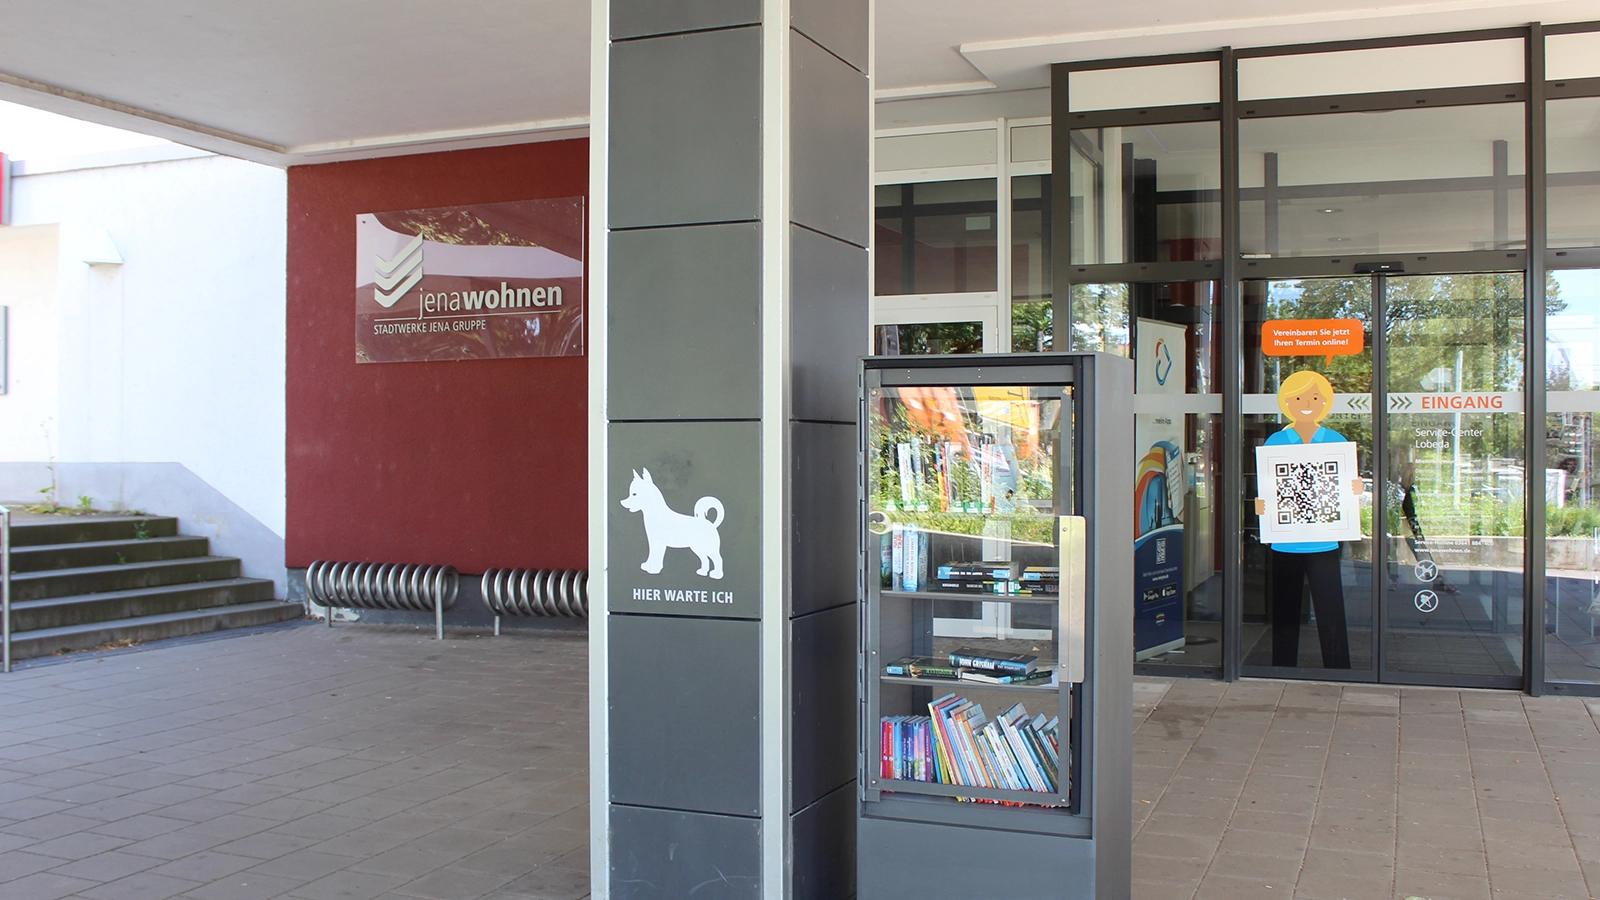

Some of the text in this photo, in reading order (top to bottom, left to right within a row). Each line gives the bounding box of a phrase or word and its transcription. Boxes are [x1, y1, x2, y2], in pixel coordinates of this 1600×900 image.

[418, 282, 562, 320] jenawohnen
[373, 319, 486, 335] STADTWERKE JENA GRUPPE
[1272, 328, 1350, 337] Vereinbaren Sie jetzt
[1273, 339, 1294, 347] Ihren
[1321, 338, 1349, 346] online!
[1421, 395, 1503, 410] EINGANG
[1415, 439, 1450, 449] Lobeda
[632, 587, 733, 604] HIER WARTE ICH
[959, 657, 972, 667] JOHN
[972, 659, 995, 670] GRISHAM
